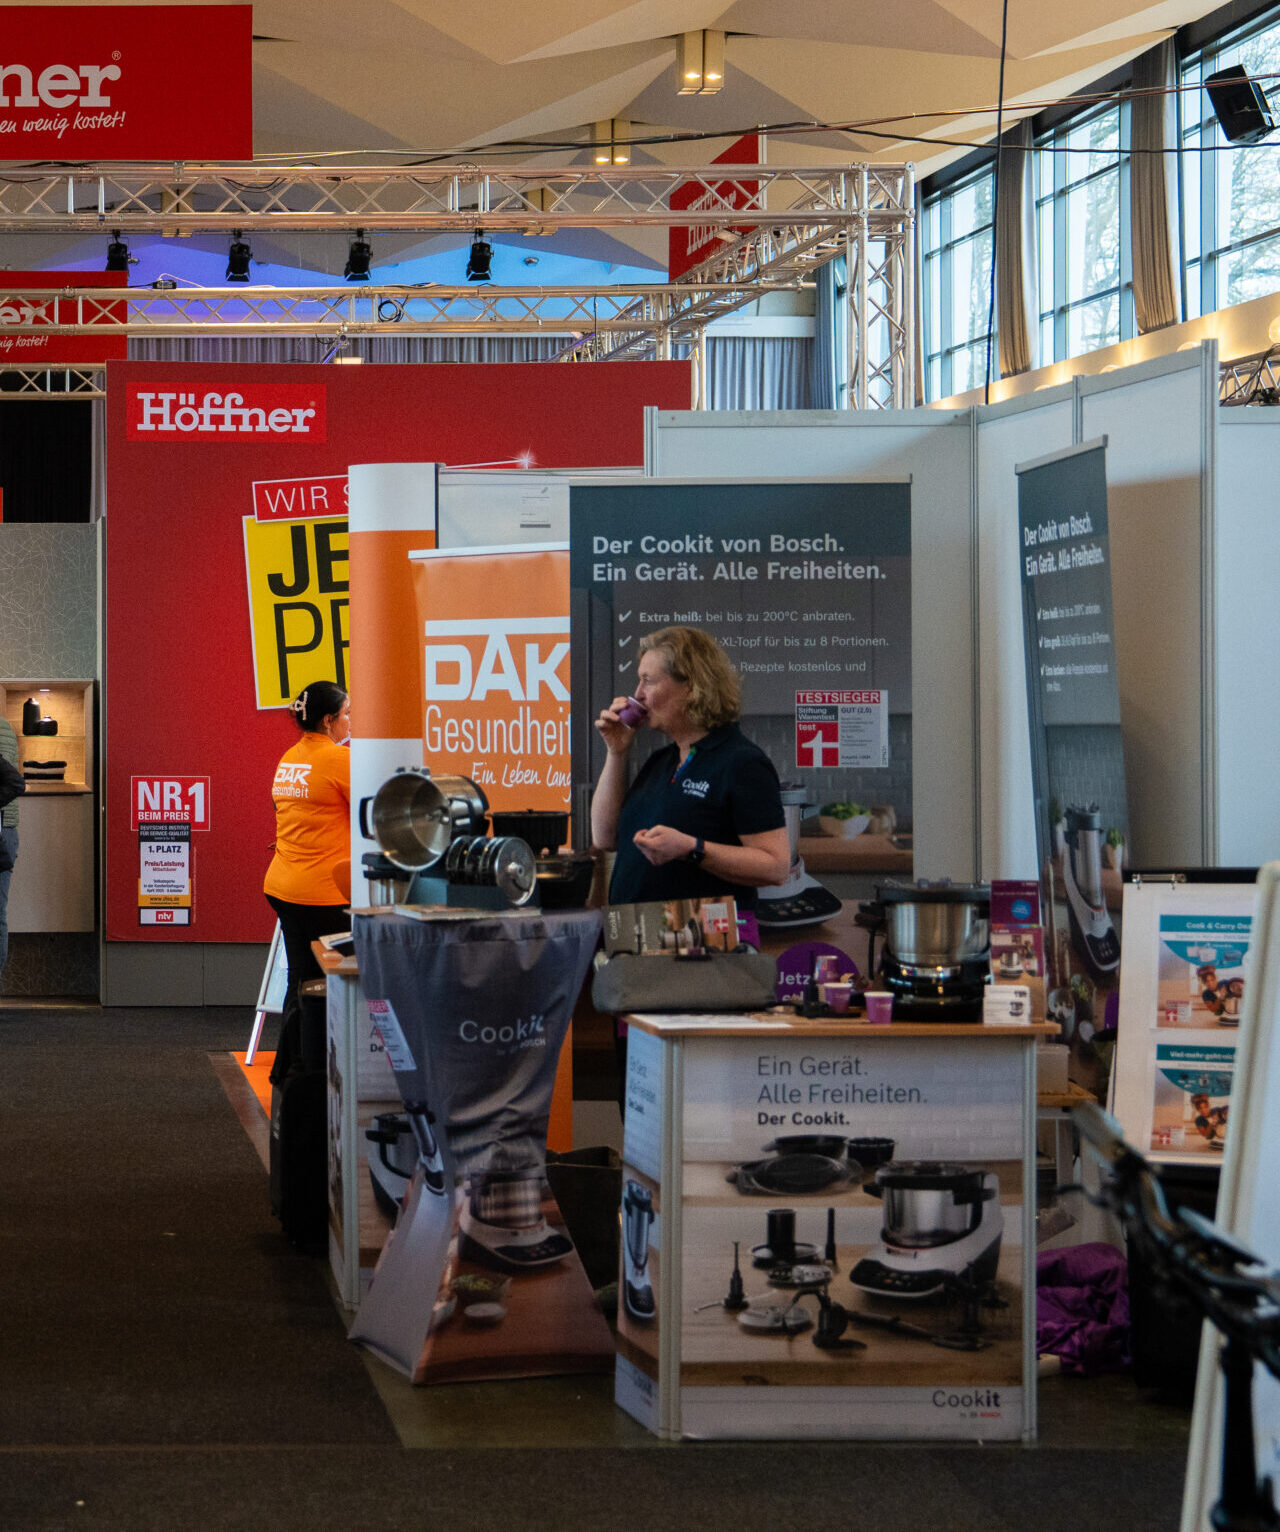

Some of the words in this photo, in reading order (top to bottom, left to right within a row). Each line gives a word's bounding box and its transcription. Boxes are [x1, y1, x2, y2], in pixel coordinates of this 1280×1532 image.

[22, 112, 70, 139] wenig
[73, 111, 126, 130] kostet!
[16, 335, 48, 348] kostet!
[136, 392, 316, 433] Höffner
[264, 485, 328, 513] WIR
[592, 536, 632, 554] Der
[640, 534, 713, 554] Cookit
[721, 538, 761, 553] von
[770, 533, 845, 552] Bosch.
[1024, 526, 1037, 547] Der
[1038, 519, 1058, 543] Cookit
[1058, 523, 1070, 539] von
[592, 562, 627, 581] Ein
[635, 561, 705, 581] Gerät.
[713, 561, 758, 581] Alle
[767, 560, 887, 580] Freiheiten.
[1026, 555, 1038, 576] Ein
[1058, 548, 1071, 570] Alle
[639, 612, 670, 623] Extra
[674, 611, 702, 622] heiß:
[706, 611, 723, 622] bei
[727, 611, 743, 622] bis
[747, 614, 759, 622] zu
[802, 611, 855, 622] anbraten.
[764, 635, 780, 646] für
[784, 635, 800, 646] bis
[804, 638, 816, 647] zu
[820, 636, 828, 647] 8
[831, 636, 889, 647] Portionen.
[425, 616, 570, 701] DAK
[740, 661, 785, 674] Rezepte
[788, 661, 842, 672] kostenlos
[845, 661, 866, 672] und
[797, 692, 880, 703] TESTSIEGER
[799, 723, 817, 731] test
[471, 761, 496, 785] Ein
[501, 760, 542, 788] Leben
[138, 811, 161, 821] BEIM
[163, 811, 190, 820] PREIS
[156, 845, 182, 853] PLATZ
[778, 971, 811, 986] Jetz
[459, 1014, 545, 1043] Cookit
[757, 1055, 792, 1076] Ein
[799, 1055, 869, 1077] Gerät.
[757, 1083, 802, 1104] Alle
[808, 1083, 928, 1104] Freiheiten.
[757, 1112, 786, 1126] Der
[791, 1110, 851, 1126] Cookit.
[932, 1389, 1001, 1408] Cookit
